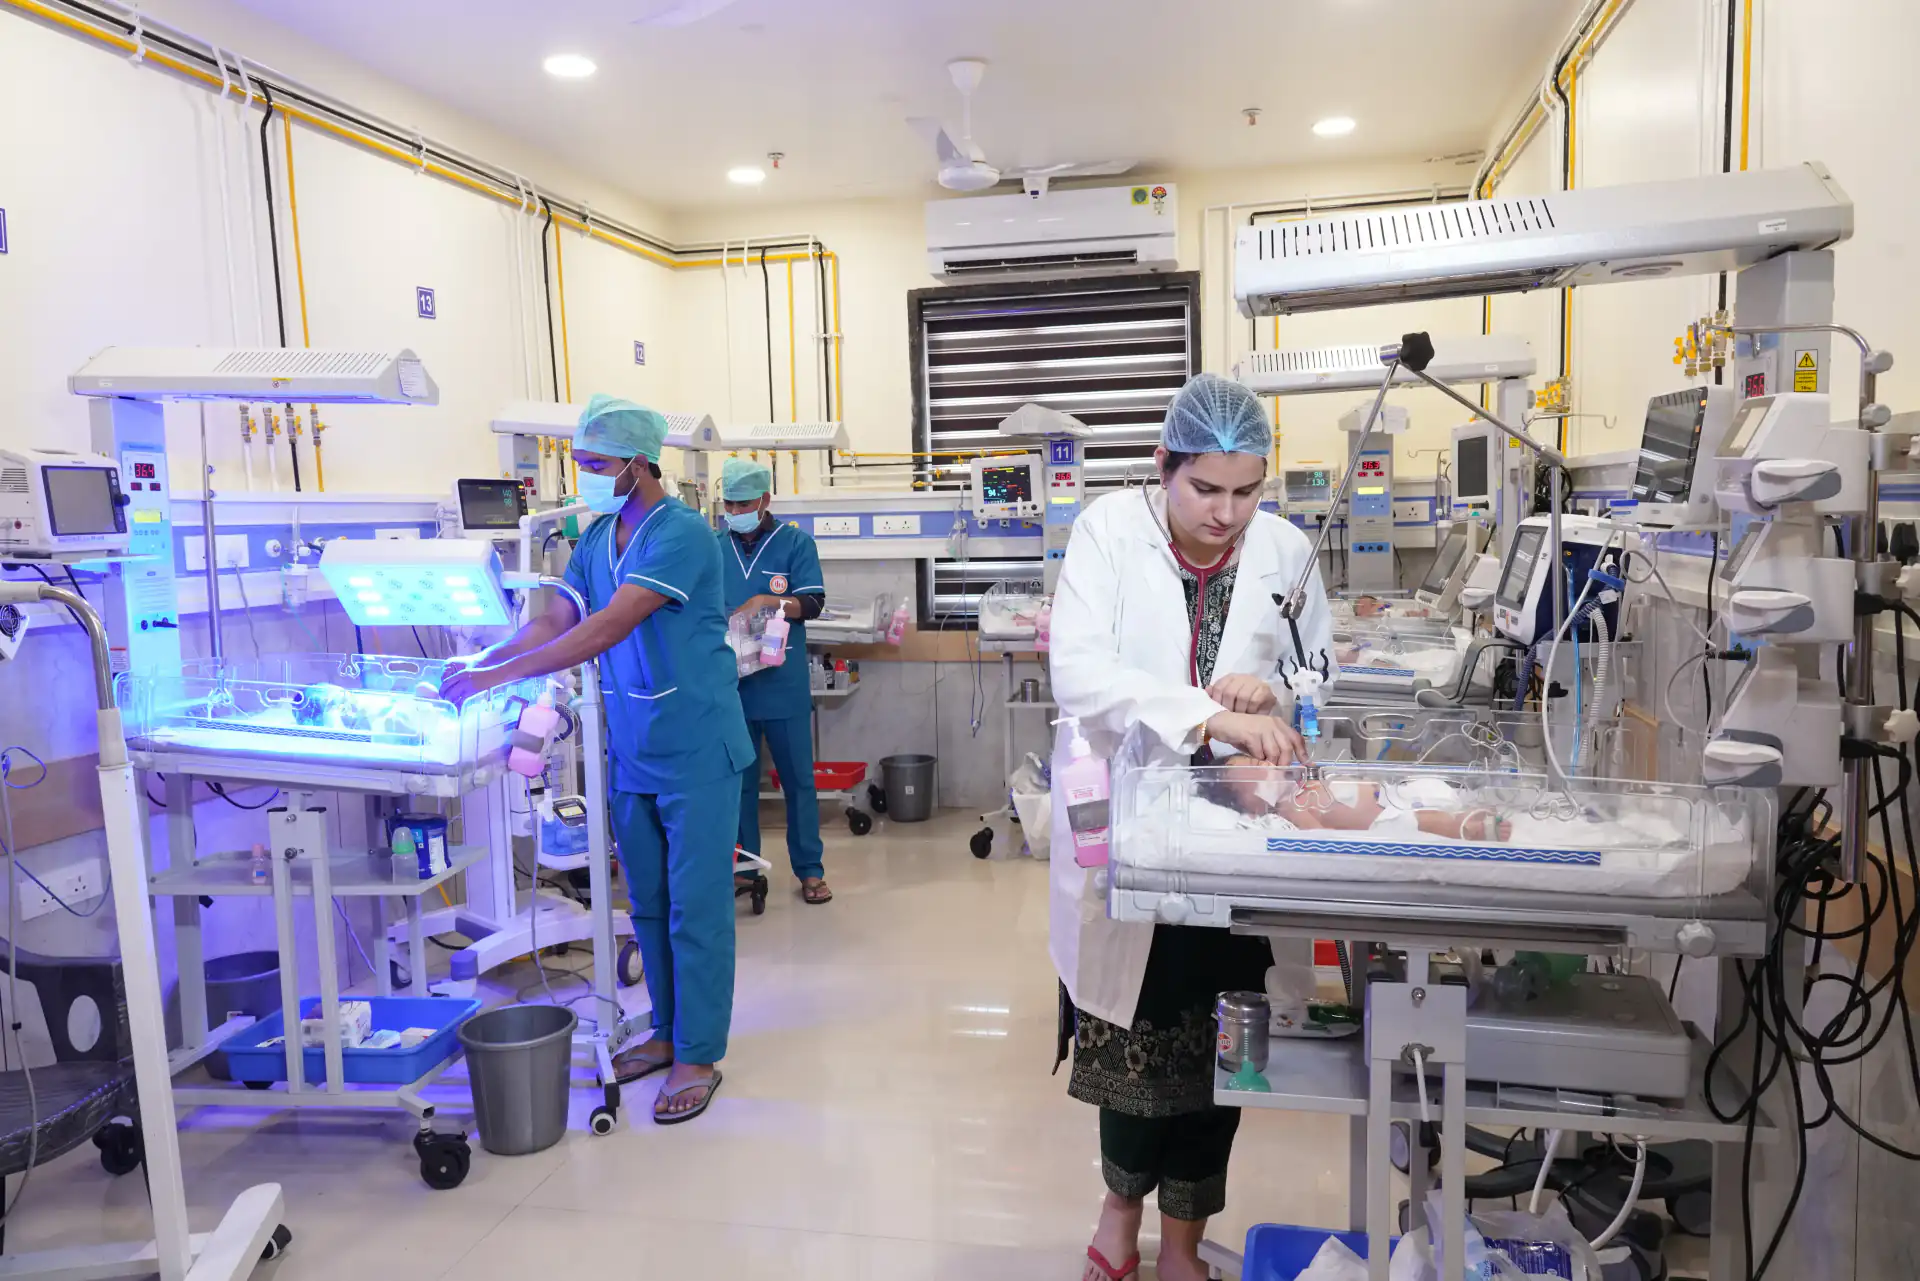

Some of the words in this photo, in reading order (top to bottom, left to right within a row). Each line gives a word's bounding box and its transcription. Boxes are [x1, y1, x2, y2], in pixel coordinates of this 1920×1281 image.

[420, 294, 433, 312] 13
[1056, 446, 1070, 460] 11
[1311, 478, 1325, 486] 130
